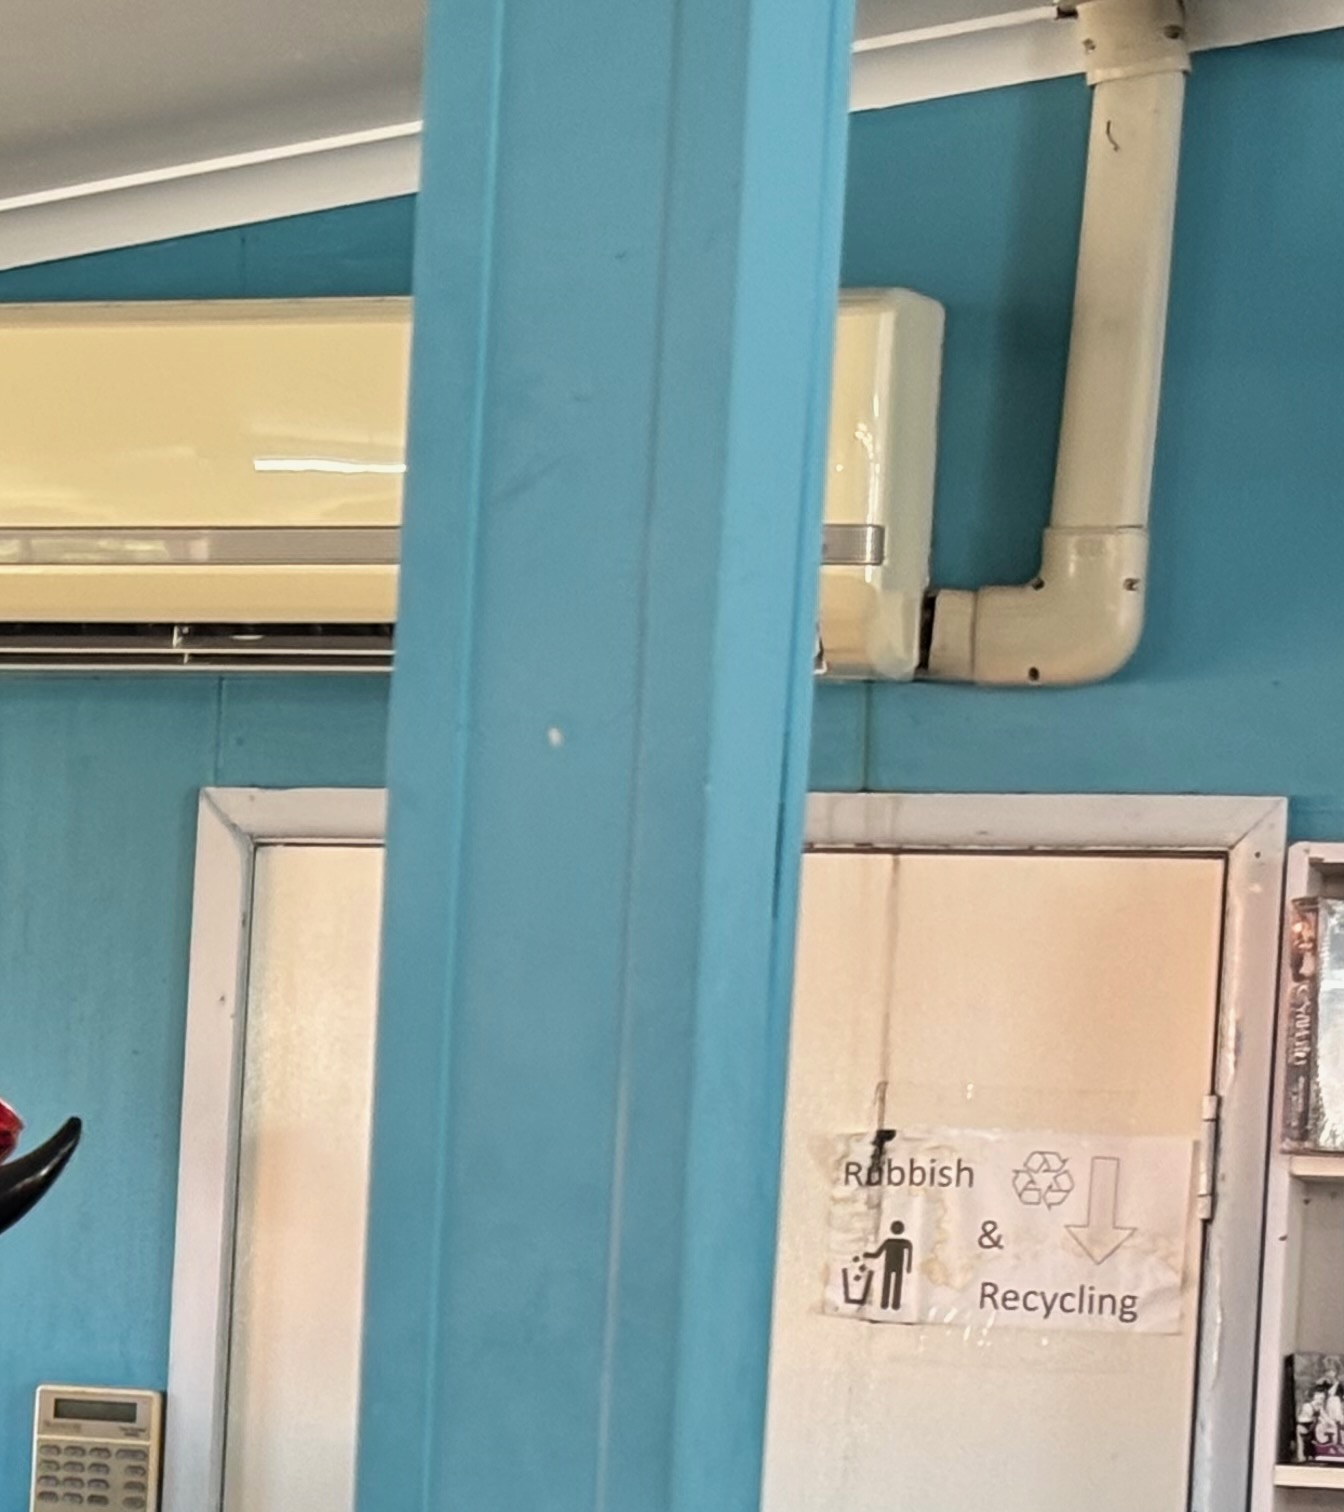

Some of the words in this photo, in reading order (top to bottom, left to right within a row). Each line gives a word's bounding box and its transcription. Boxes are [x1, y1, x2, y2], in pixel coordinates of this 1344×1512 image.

[844, 1158, 975, 1188] Rubbish
[977, 1220, 1004, 1250] &
[979, 1281, 1138, 1323] Recycling
